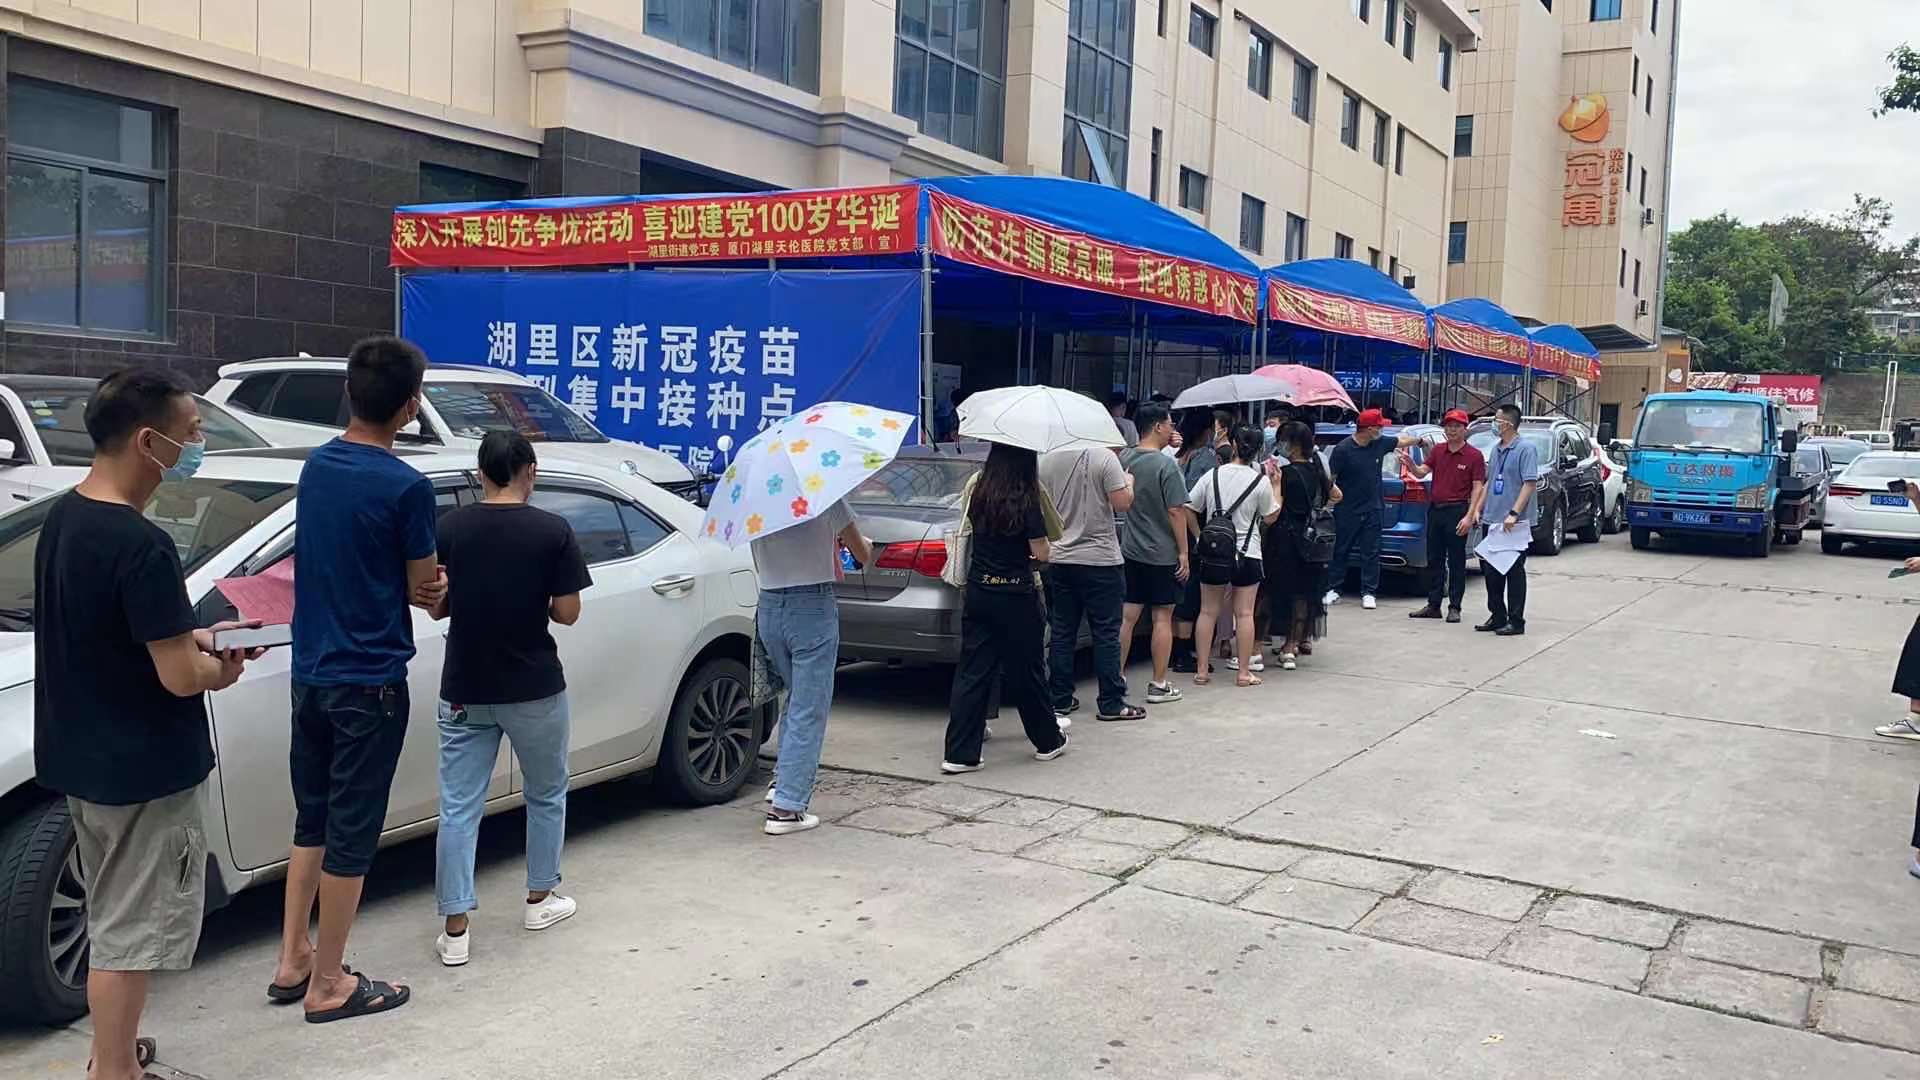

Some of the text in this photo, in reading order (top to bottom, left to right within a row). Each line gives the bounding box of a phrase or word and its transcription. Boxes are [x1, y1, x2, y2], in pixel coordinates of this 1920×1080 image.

[395, 191, 902, 249] 深入开展创先争优活动 喜迎建党100岁华诞
[487, 321, 800, 377] 湖里区新冠疫苗
